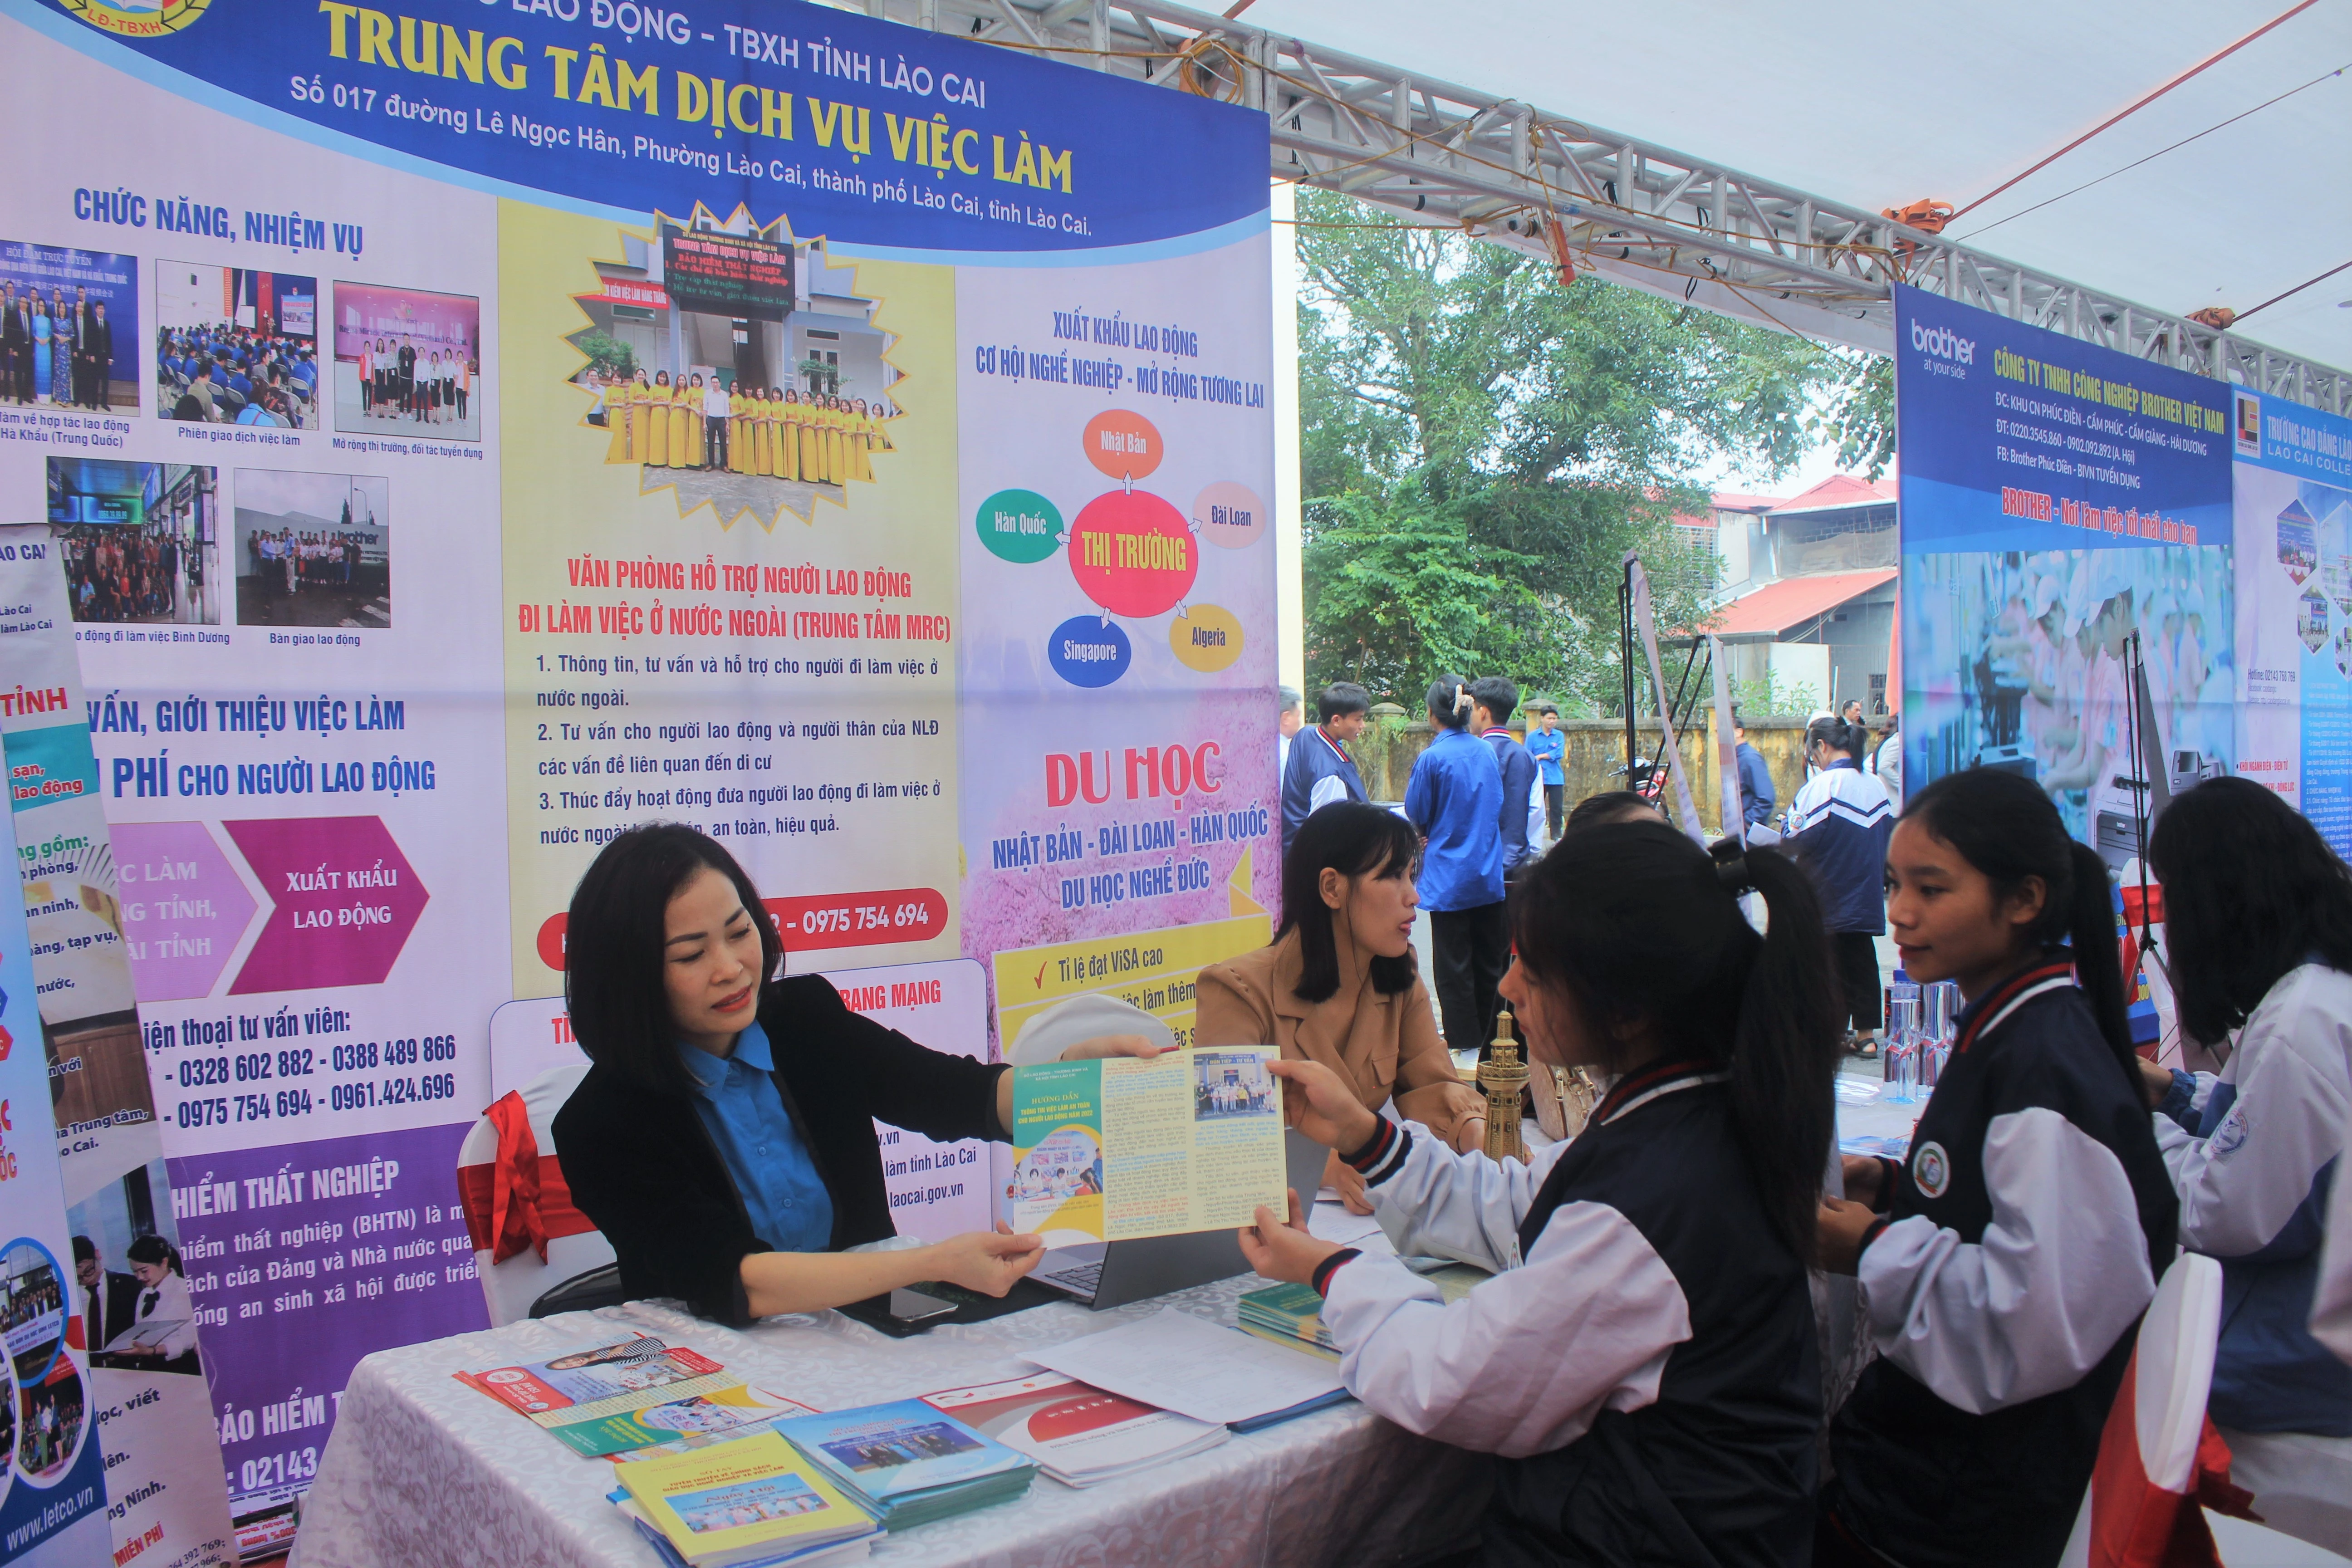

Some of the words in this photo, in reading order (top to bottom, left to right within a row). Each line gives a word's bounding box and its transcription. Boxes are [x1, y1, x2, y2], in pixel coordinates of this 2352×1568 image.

[87, 9, 162, 33] LĐ-TBXH
[725, 24, 799, 68] TBXH
[808, 37, 871, 84] TỈNH
[881, 54, 933, 96] LÀO
[941, 73, 985, 108] CAI
[318, 0, 528, 89] TRUNG
[544, 43, 660, 116] TÂM
[676, 70, 794, 139] DỊCH
[806, 96, 871, 164] VỤ
[883, 113, 979, 180] VIỆC
[993, 131, 1073, 194] LÀM
[291, 74, 324, 103] Số
[333, 82, 377, 112] 017
[386, 93, 467, 133] đường
[476, 108, 503, 134] Lê
[511, 115, 571, 149] Ngọc
[578, 125, 627, 159] Hân,
[634, 134, 720, 175] Phường
[727, 152, 764, 179] Lào
[769, 157, 807, 189] Cai,
[813, 167, 867, 196] thành
[872, 177, 907, 204] phố
[913, 185, 945, 211] Lào
[951, 192, 984, 219] Cai,
[989, 199, 1021, 224] tỉnh
[1026, 206, 1057, 230] Lào
[1062, 212, 1092, 236] Cai.
[74, 186, 147, 228] CHỨC
[156, 196, 236, 243] NĂNG,
[245, 211, 325, 254] NHIỆM
[333, 224, 363, 262] VỤ
[1911, 318, 1975, 365] brother
[1924, 358, 1931, 371] at
[1933, 361, 1950, 376] your
[1951, 364, 1965, 380] side
[1994, 346, 2025, 382] CÔNG
[2028, 358, 2040, 386] TY
[2043, 363, 2071, 395] TNHH
[2073, 369, 2102, 403] CÔNG
[2104, 382, 2139, 416] NGHIỆP
[2141, 391, 2182, 424] BROTHER
[2184, 400, 2202, 433] VIỆT
[2205, 408, 2224, 435] NAM
[178, 427, 207, 439] Phiên
[211, 430, 232, 441] giao
[235, 432, 256, 444] dịch
[259, 433, 279, 446] việc
[282, 434, 300, 445] làm
[348, 439, 366, 452] rộng
[369, 441, 379, 453] thị
[381, 441, 409, 455] trường,
[426, 445, 438, 455] tác
[464, 448, 482, 460] dụng
[1101, 430, 1125, 456] Nhật
[1127, 432, 1147, 454] Bản
[1996, 419, 2009, 435] ĐT:
[2010, 423, 2062, 447] 0220.3545.860
[2068, 436, 2111, 458] 0902.092.892
[2112, 446, 2121, 461] (A.
[2122, 449, 2135, 465] Hội)
[2268, 443, 2291, 459] LAO
[2294, 450, 2313, 466] CAI
[1997, 446, 2009, 461] FB:
[2010, 449, 2037, 468] Brother
[2038, 455, 2054, 471] Phúc
[2056, 459, 2072, 475] Điền
[2078, 464, 2094, 480] BIVN
[2096, 466, 2118, 485] TUYỂN
[2120, 475, 2140, 490] DỤNG
[995, 511, 1016, 533] Hàn
[1019, 511, 1047, 535] Quốc
[1211, 505, 1227, 526] Đài
[1230, 507, 1251, 527] Loan
[2002, 486, 2051, 522] BROTHER
[2061, 497, 2078, 527] Nơi
[2082, 502, 2100, 531] làm
[2102, 506, 2123, 539] việc
[2126, 507, 2138, 537] tốt
[2140, 510, 2160, 541] nhất
[2162, 518, 2178, 543] cho
[2180, 519, 2196, 549] bạn
[1082, 531, 1111, 575] THỊ
[1116, 527, 1186, 571] TRƯỜNG
[568, 553, 610, 588] VĂN
[616, 555, 685, 590] PHÒNG
[691, 554, 716, 591] HỖ
[724, 564, 759, 598] TRỢ
[764, 561, 820, 595] NGƯỜI
[827, 569, 858, 597] LAO
[864, 566, 911, 603] ĐỘNG
[1064, 639, 1117, 663] Singapore
[1192, 626, 1225, 647] Algeria
[536, 655, 551, 671] 1.
[558, 655, 607, 676] Thông
[614, 656, 638, 675] tin,
[645, 657, 661, 672] tư
[667, 654, 693, 672] vấn
[701, 657, 717, 672] và
[725, 654, 741, 672] hỗ
[748, 657, 768, 676] trợ
[774, 657, 799, 673] cho
[806, 657, 843, 676] người
[850, 658, 862, 674] đi
[868, 658, 892, 674] làm
[898, 659, 924, 677] việc
[931, 658, 938, 674] ở
[13, 764, 45, 780] sạn,
[14, 786, 39, 799] lao
[42, 780, 83, 797] động
[1045, 750, 1111, 807] DU
[1125, 741, 1220, 810] HỌC
[1058, 957, 1070, 982] Tỉ
[1074, 959, 1085, 984] lệ
[1089, 955, 1107, 977] đạt
[1111, 947, 1139, 972] ViSA
[1143, 948, 1163, 967] cao
[178, 1097, 227, 1129] 0975
[234, 1094, 270, 1122] 754
[276, 1091, 312, 1117] 694
[331, 1073, 455, 1112] 0961.424.696
[244, 1162, 304, 1209] THẤT
[312, 1156, 399, 1200] NGHIỆP
[890, 1183, 963, 1208] laocai.gov.vn
[7, 1486, 93, 1552] www.letco.vn
